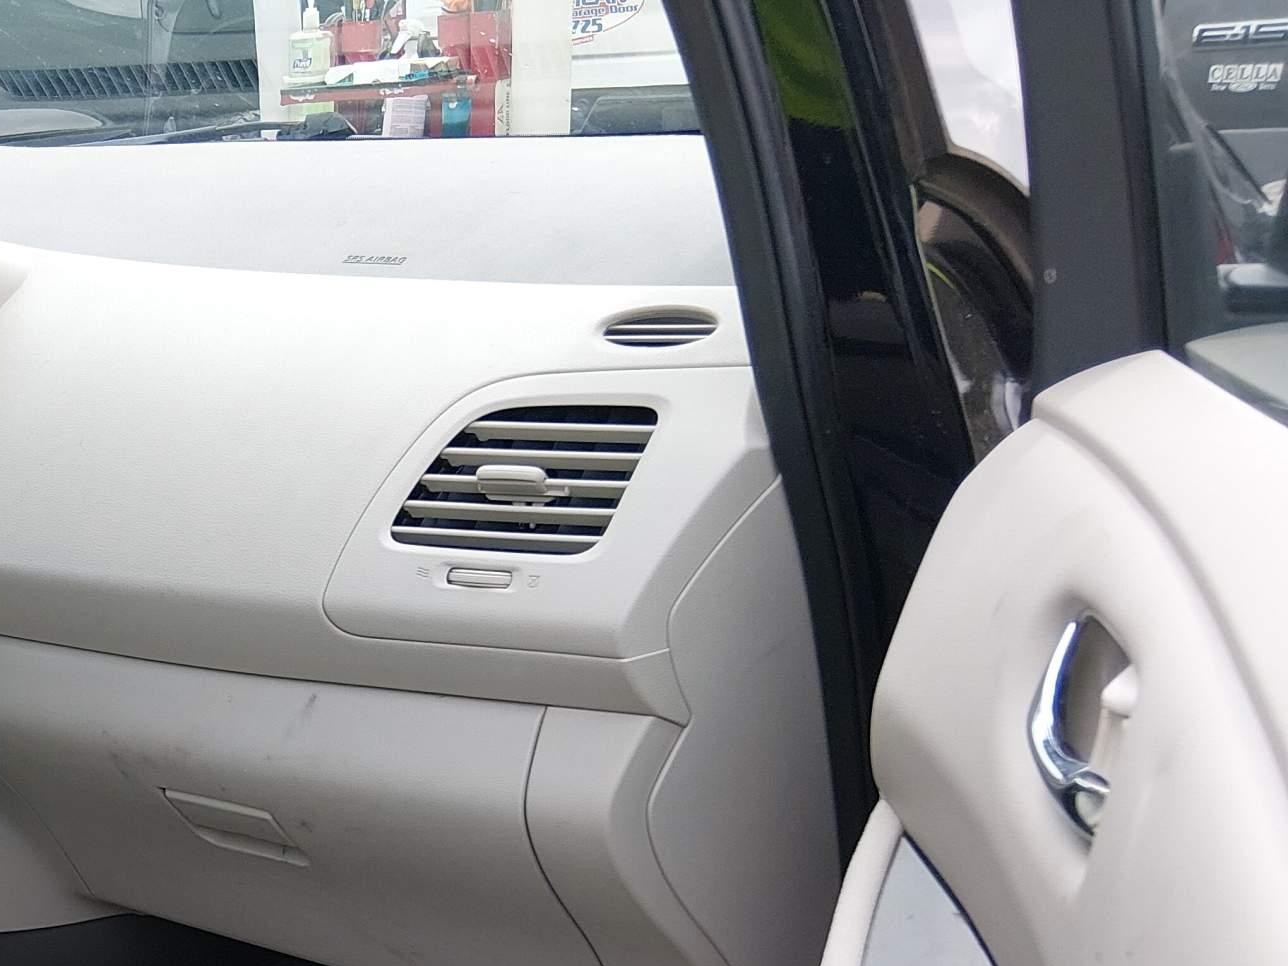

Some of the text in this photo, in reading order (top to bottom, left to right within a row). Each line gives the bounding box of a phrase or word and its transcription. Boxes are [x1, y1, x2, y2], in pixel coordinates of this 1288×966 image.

[572, 5, 638, 16] arage Door
[1193, 20, 1288, 46] F-15
[1209, 65, 1283, 82] CELLA
[366, 256, 408, 264] AIRBAG
